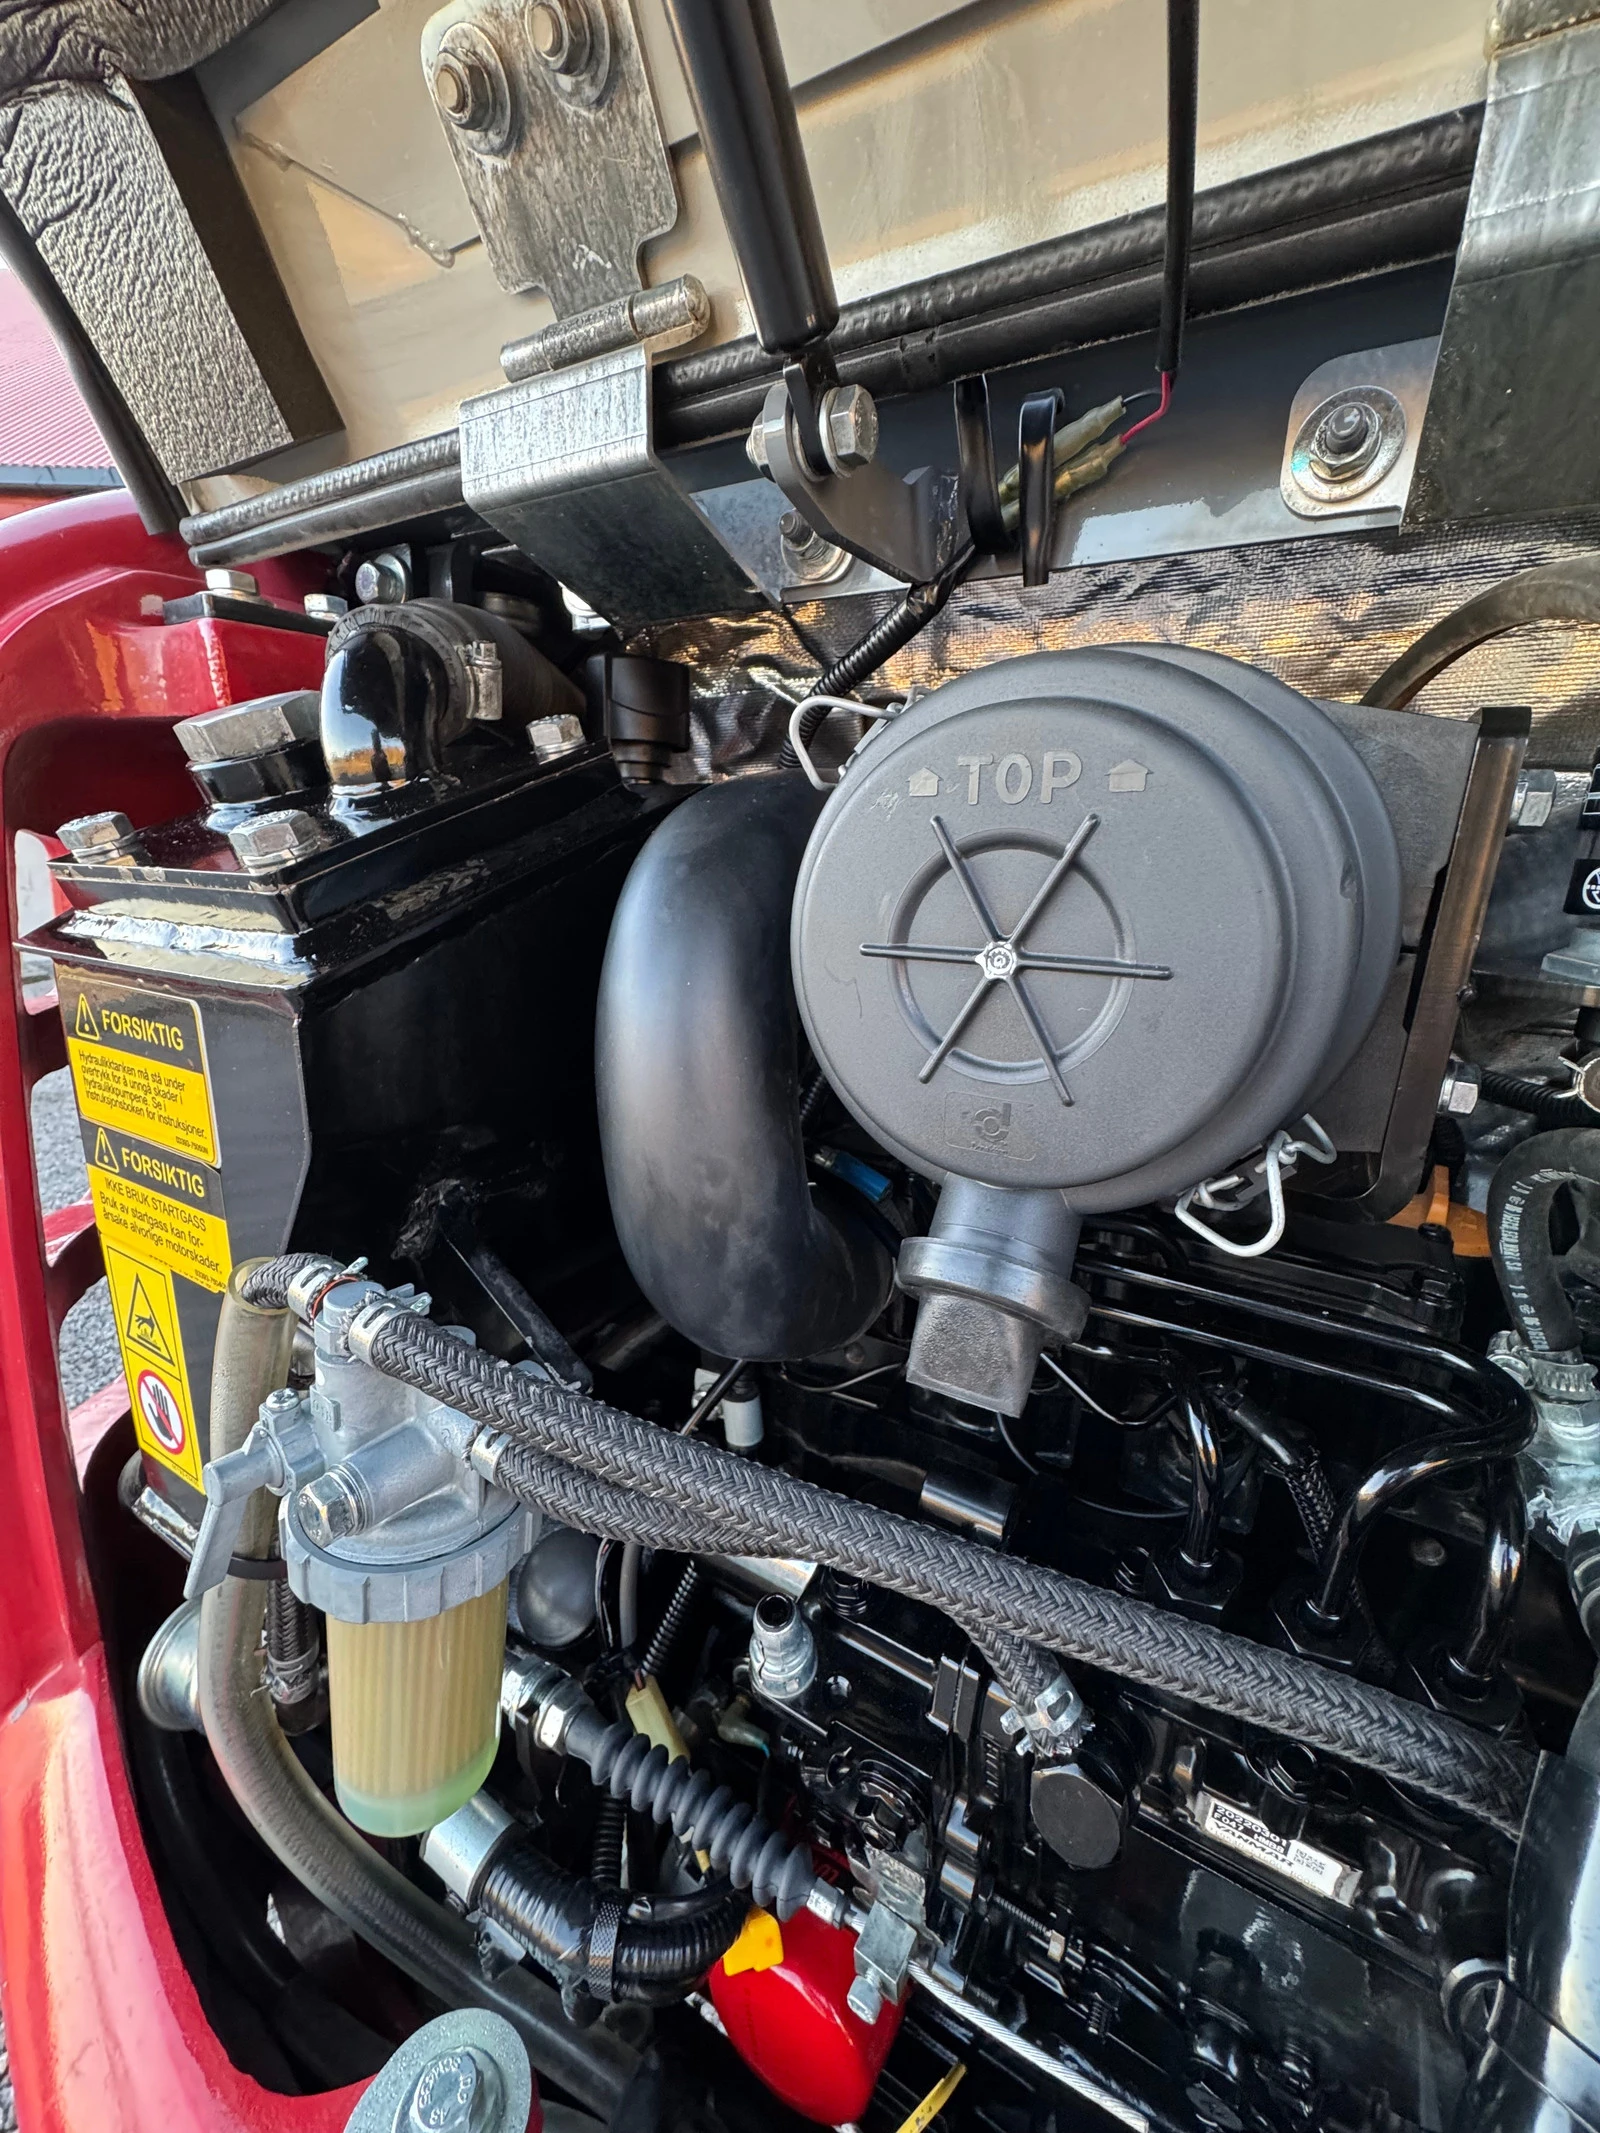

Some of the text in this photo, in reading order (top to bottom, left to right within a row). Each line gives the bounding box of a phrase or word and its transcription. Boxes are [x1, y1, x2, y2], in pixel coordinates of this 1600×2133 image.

[957, 751, 1083, 804] TOP
[102, 1009, 184, 1051] FORSIKTIG
[81, 1065, 111, 1081] overtrykk
[111, 1070, 121, 1084] for
[123, 1076, 128, 1087] å
[129, 1079, 151, 1095] unngå
[153, 1085, 178, 1103] skader
[138, 1068, 149, 1080] må
[151, 1072, 162, 1085] stå
[164, 1076, 185, 1092] under
[145, 1107, 156, 1121] for
[157, 1111, 207, 1139] instruksjoner.
[151, 1096, 162, 1110] Se
[121, 1147, 205, 1198] FORSIKTIG
[100, 1190, 204, 1248] Bruk av startgass kan for-
[105, 1177, 207, 1232] IKKE BRUK STARTGASS
[103, 1208, 128, 1229] årsake
[130, 1222, 164, 1246] alvorlige
[166, 1239, 222, 1275] motorskader.
[1213, 1812, 1244, 1833] F047
[1216, 1805, 1287, 1846] 20220301
[1215, 1822, 1295, 1868] YANMAR
